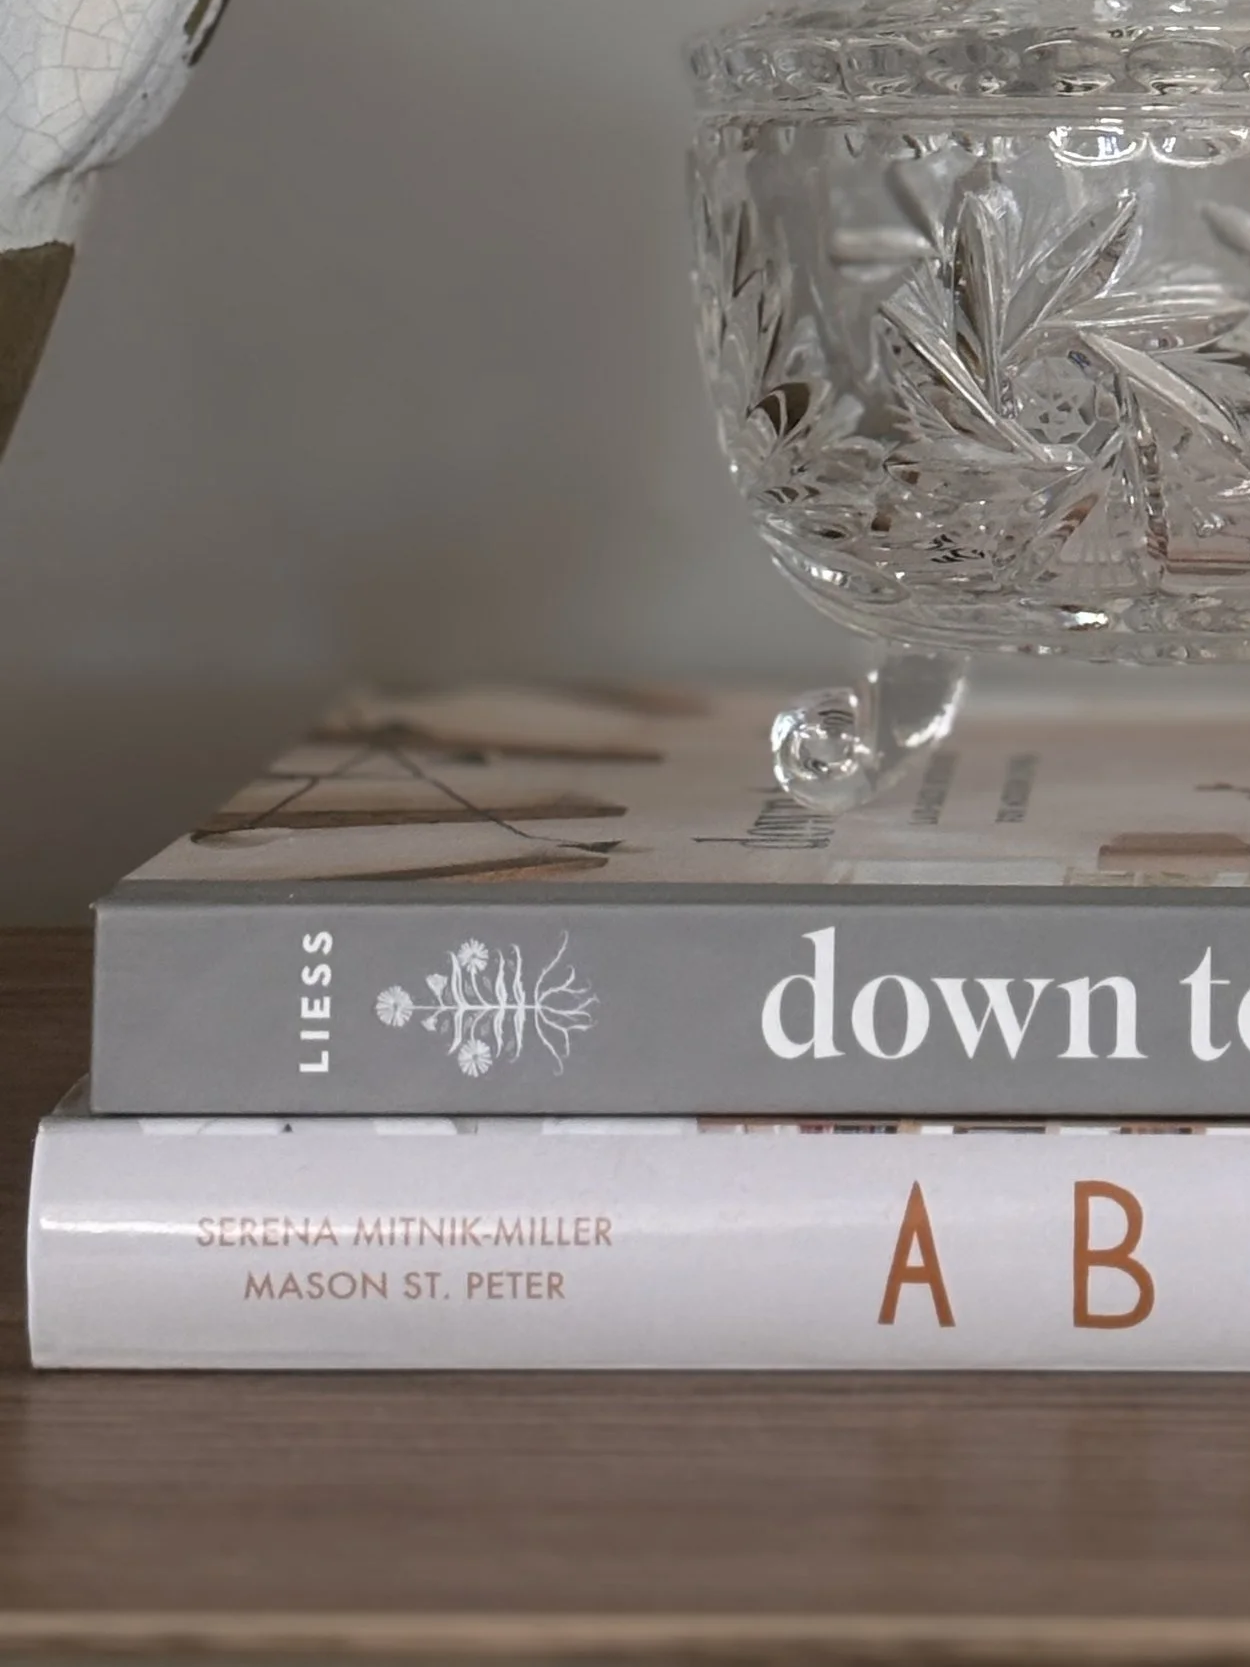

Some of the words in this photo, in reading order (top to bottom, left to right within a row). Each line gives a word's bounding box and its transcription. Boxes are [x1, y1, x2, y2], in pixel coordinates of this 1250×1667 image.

[299, 930, 333, 1073] LIESS
[761, 925, 1148, 1060] down
[196, 1218, 338, 1247] SERENA
[352, 1217, 613, 1247] MITNIK-MILLER
[244, 1271, 388, 1301] MASON
[403, 1272, 450, 1300] ST.
[467, 1271, 565, 1300] PETER
